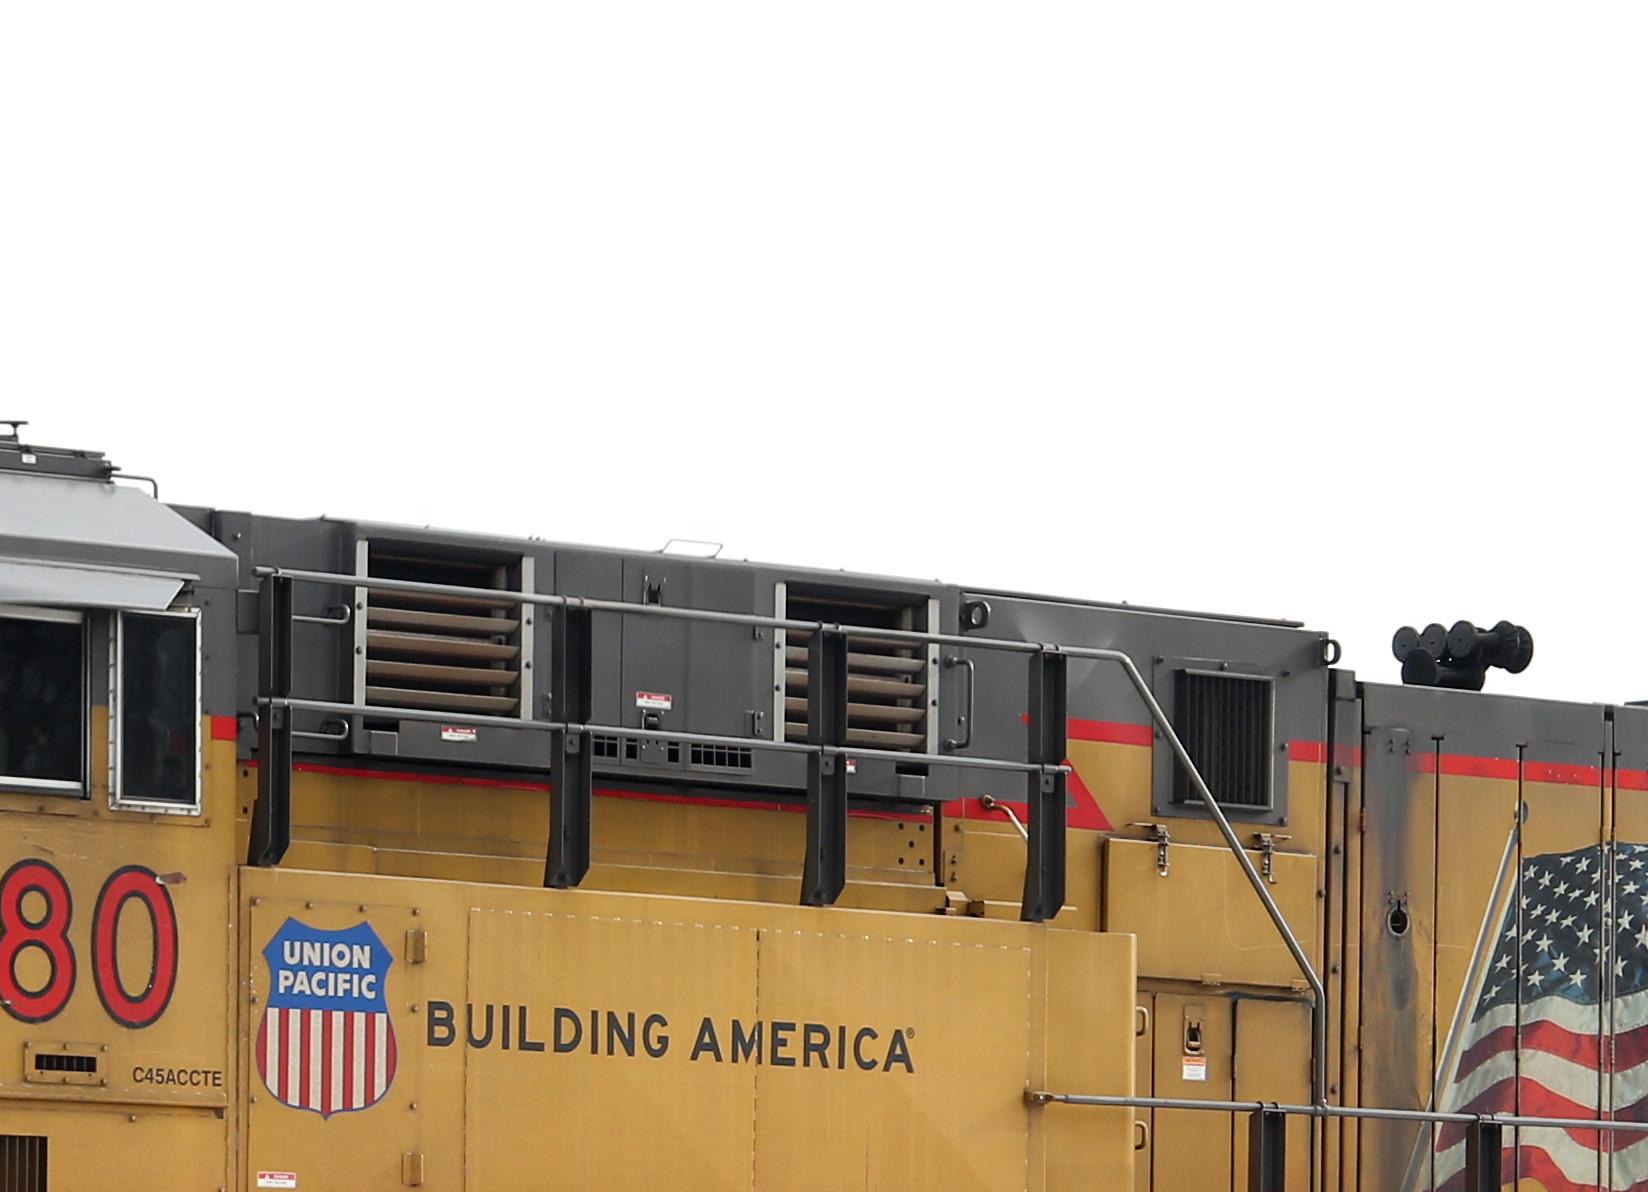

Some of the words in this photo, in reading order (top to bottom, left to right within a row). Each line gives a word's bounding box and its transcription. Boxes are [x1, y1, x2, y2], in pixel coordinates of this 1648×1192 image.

[283, 940, 371, 969] UNION
[278, 969, 376, 1000] PACIFIC
[426, 1000, 670, 1059] BUILDING
[132, 1066, 223, 1087] C45ACCTE
